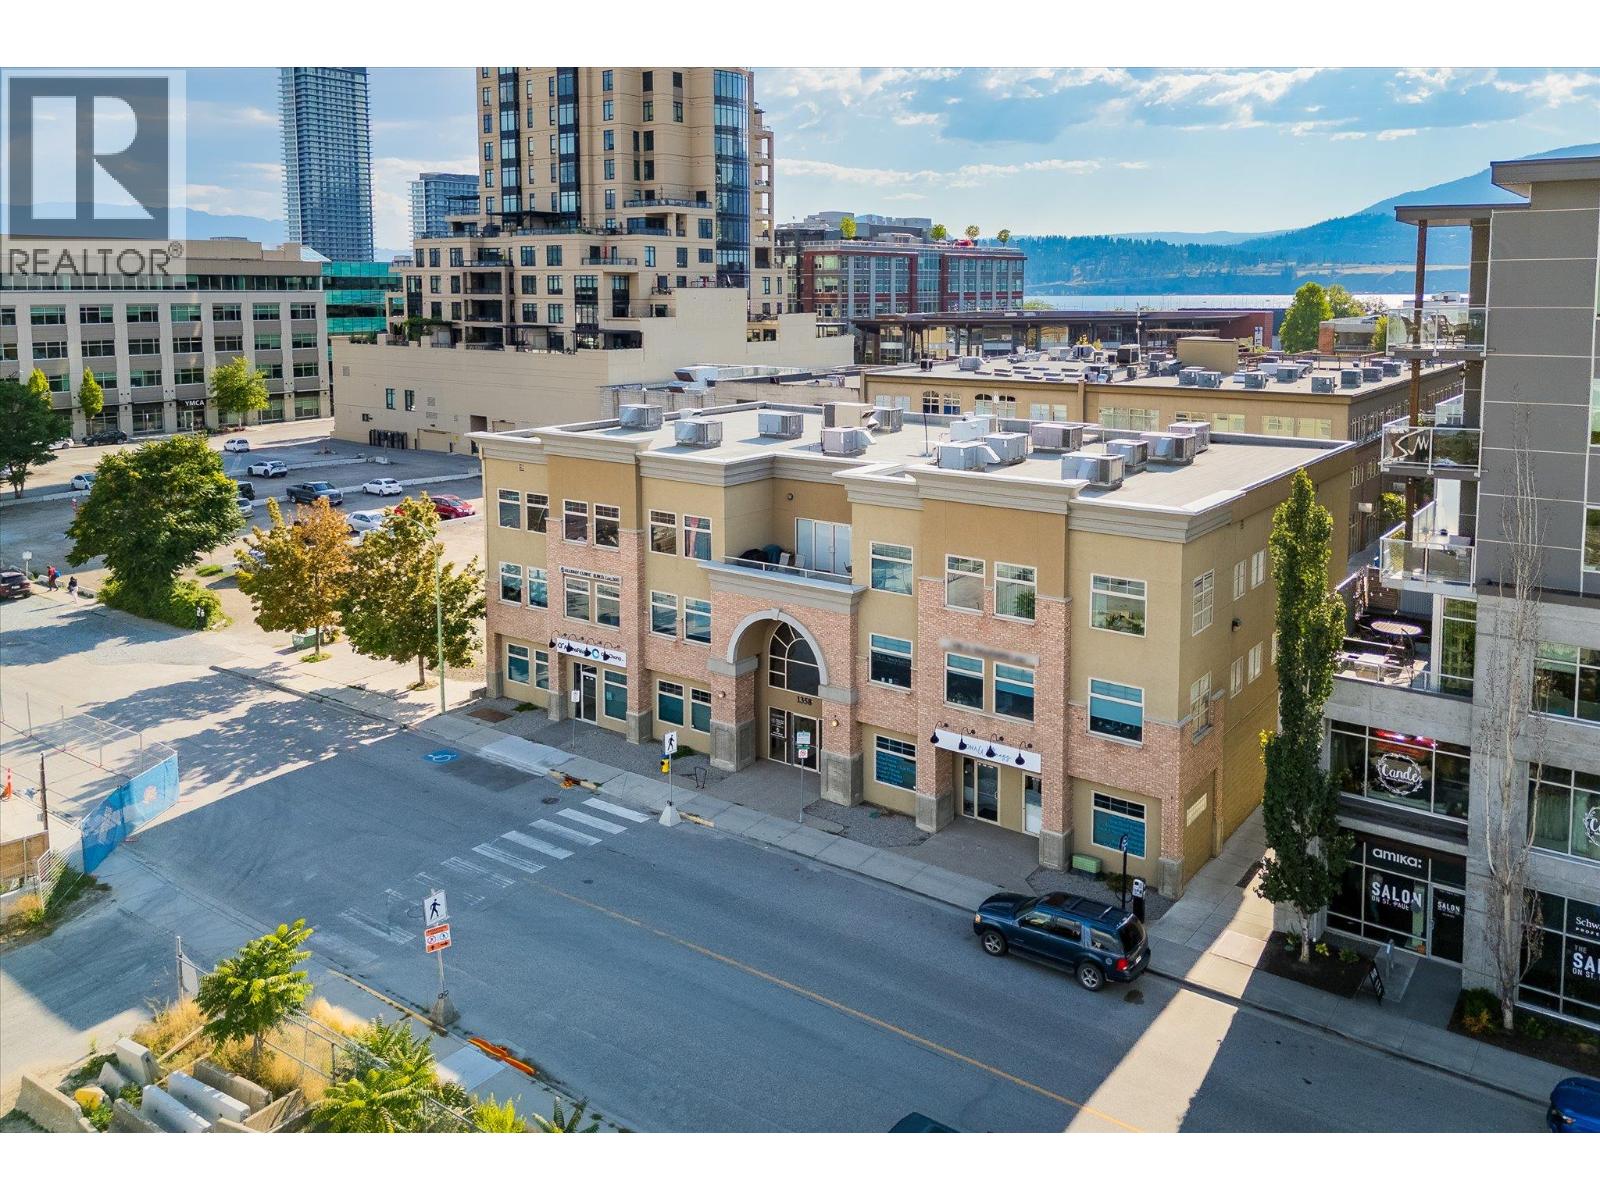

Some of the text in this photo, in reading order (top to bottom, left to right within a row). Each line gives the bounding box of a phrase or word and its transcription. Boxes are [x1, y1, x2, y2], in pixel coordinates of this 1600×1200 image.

[184, 399, 205, 407] YMCA
[797, 695, 813, 706] 1358
[1371, 881, 1422, 908] SALON
[1437, 901, 1461, 913] SALON
[1576, 916, 1600, 930] Schw
[1572, 967, 1583, 976] ON
